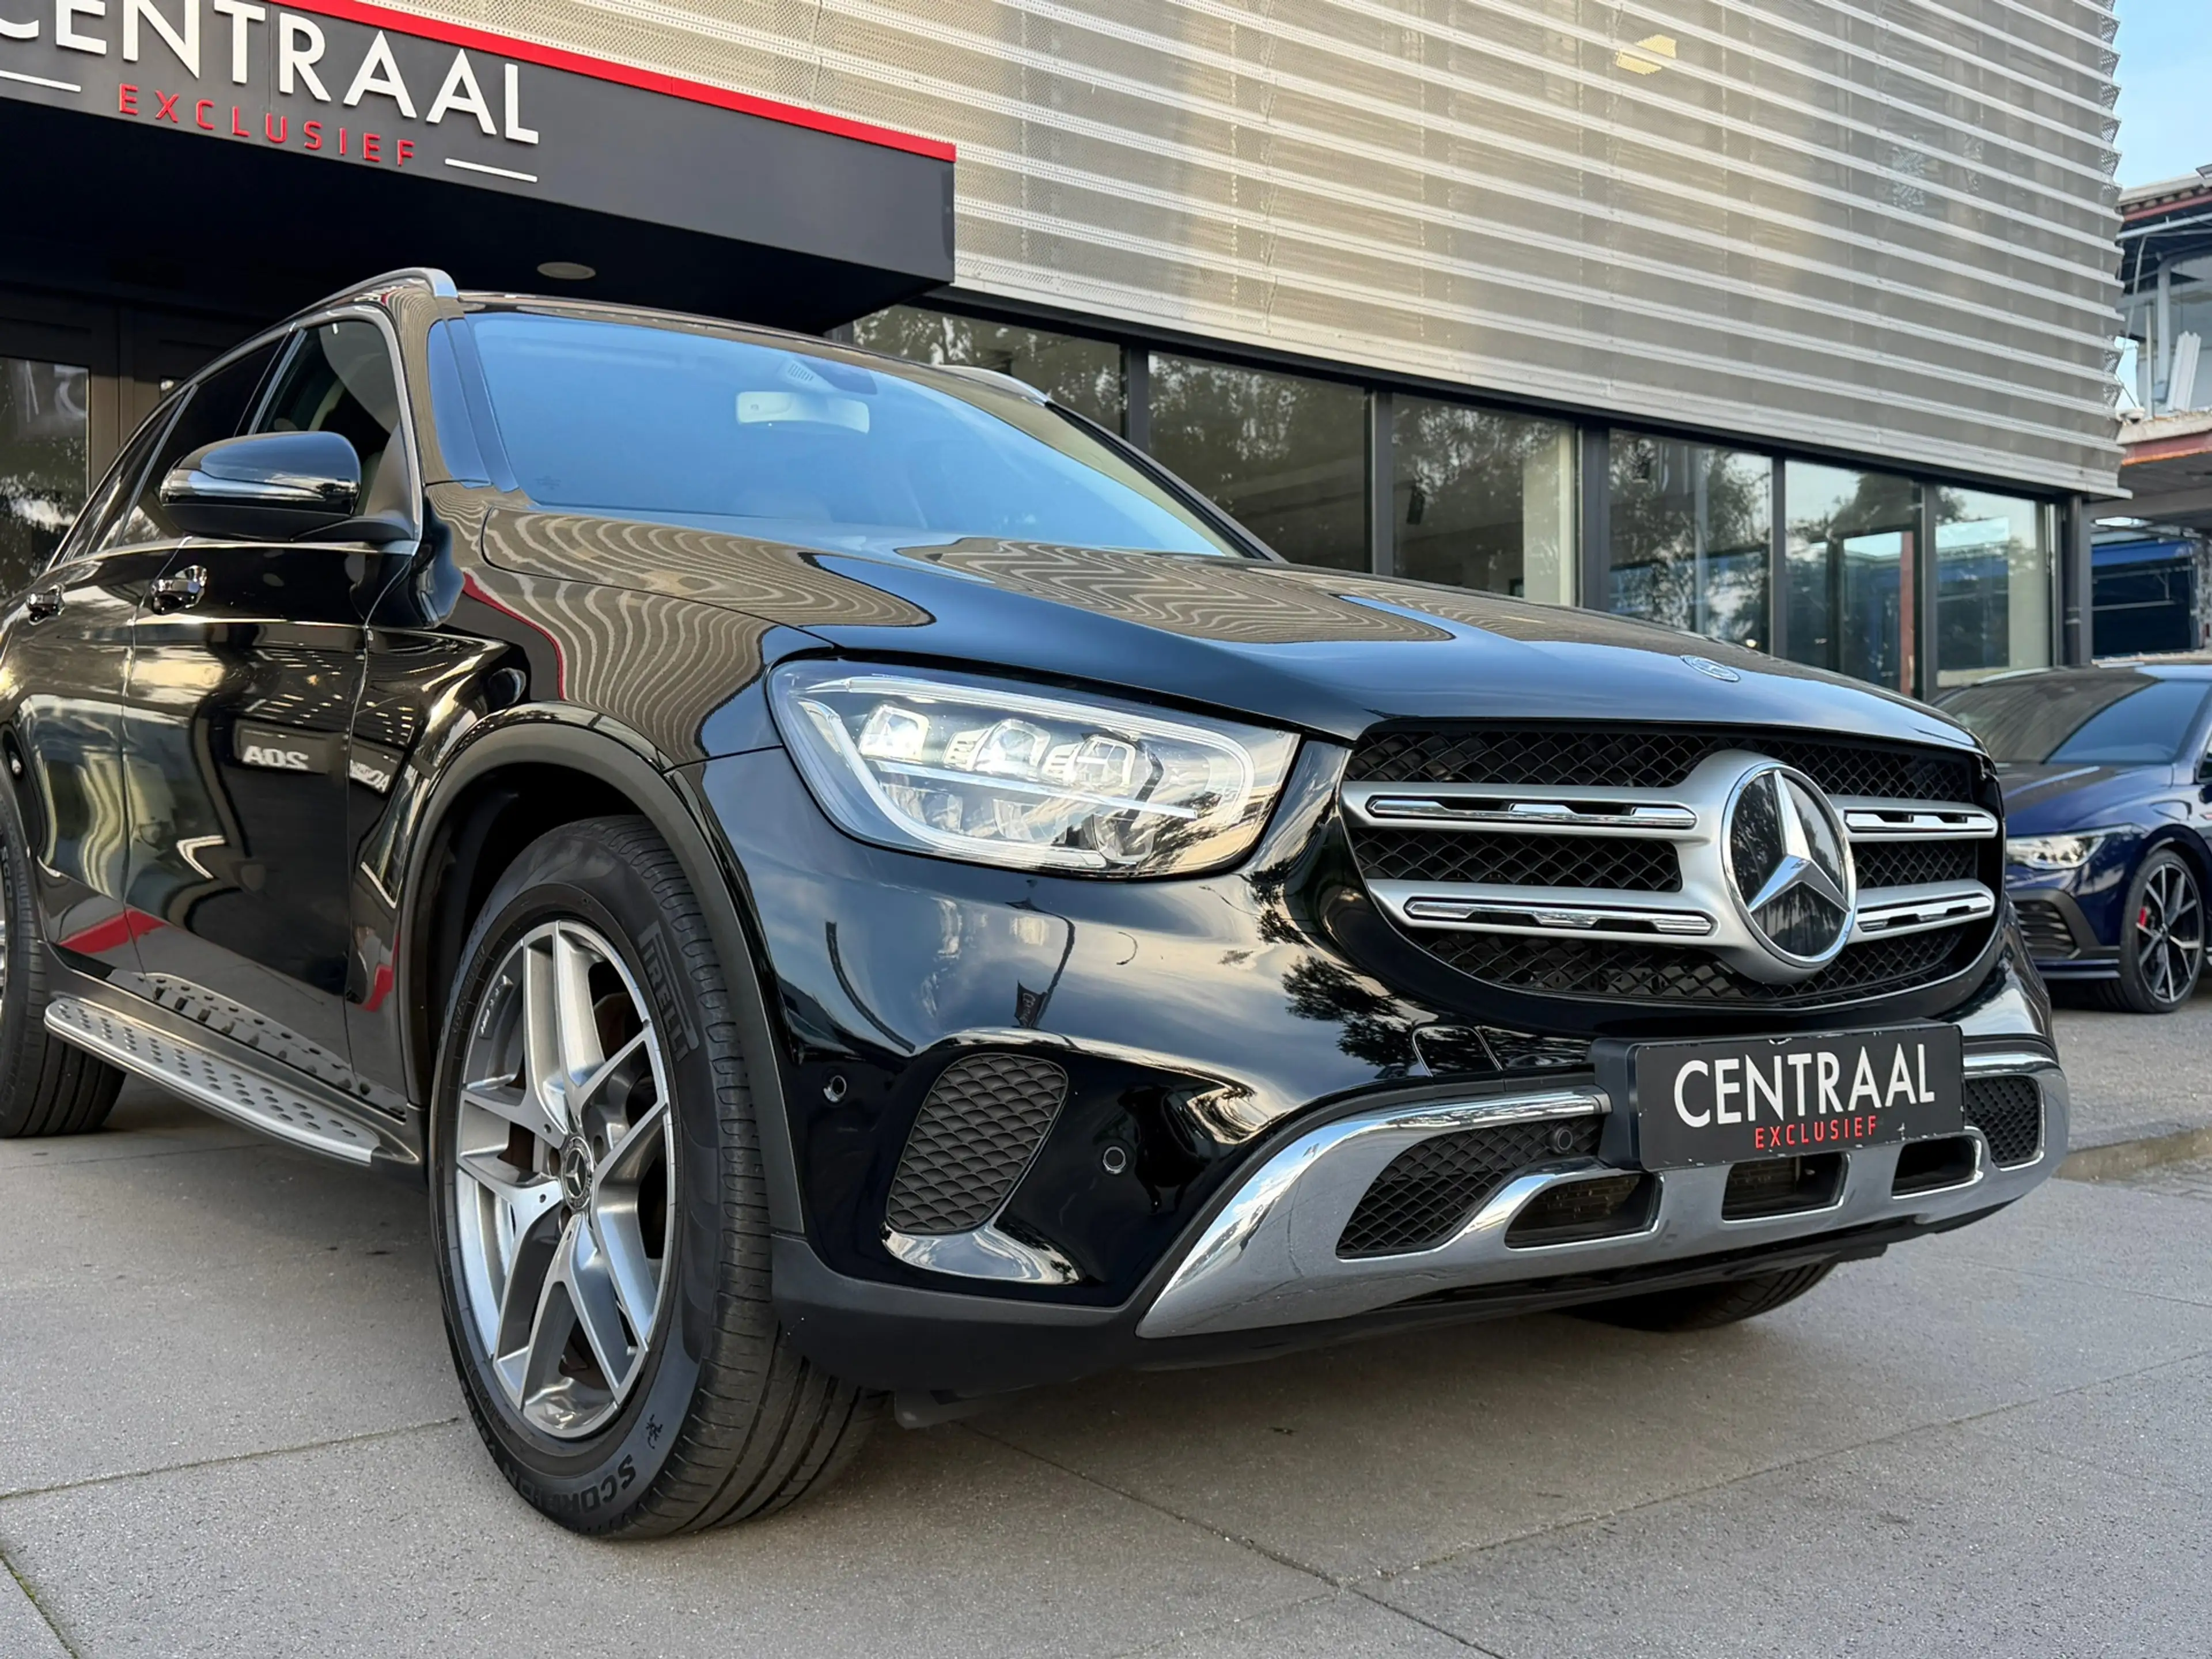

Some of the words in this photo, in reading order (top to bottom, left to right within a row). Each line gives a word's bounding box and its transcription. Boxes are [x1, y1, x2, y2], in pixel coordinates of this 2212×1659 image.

[119, 82, 415, 166] EXCLUSIEF
[637, 920, 699, 1062] PIRELLI
[1673, 1043, 1936, 1128] CENTRAAL
[1755, 1115, 1877, 1150] EXCLUSIEF
